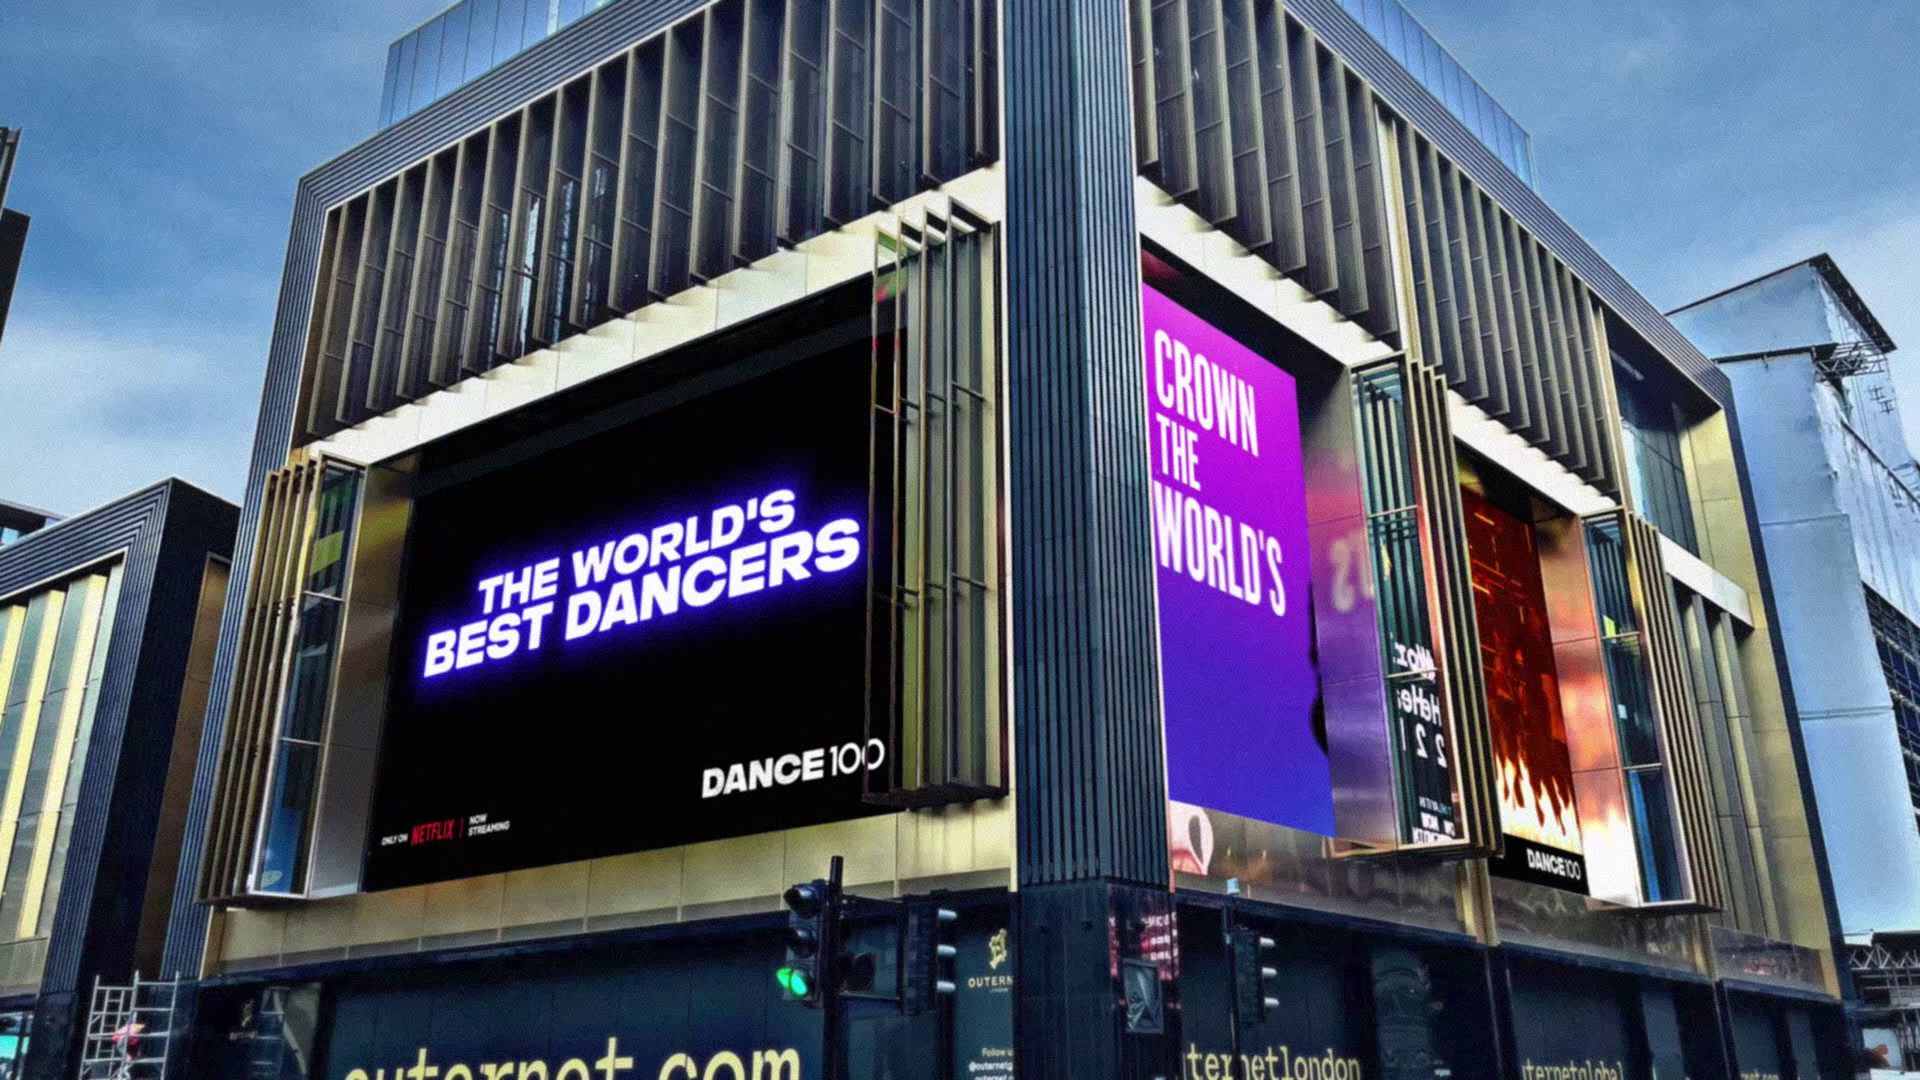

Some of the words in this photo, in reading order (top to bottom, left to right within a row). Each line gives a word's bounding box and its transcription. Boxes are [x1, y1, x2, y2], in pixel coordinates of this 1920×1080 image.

[1154, 329, 1259, 457] CROWN
[1156, 412, 1201, 491] THE
[423, 605, 555, 678] BEST
[564, 518, 861, 640] DANCERS
[478, 558, 560, 614] THE
[572, 488, 795, 584] WORLD'S
[1153, 479, 1286, 616] WORLD'S
[381, 834, 397, 846] ONLY
[398, 833, 408, 843] ON
[410, 819, 455, 846] NETFLIX
[468, 820, 510, 837] STREAMING
[469, 813, 487, 825] NOW
